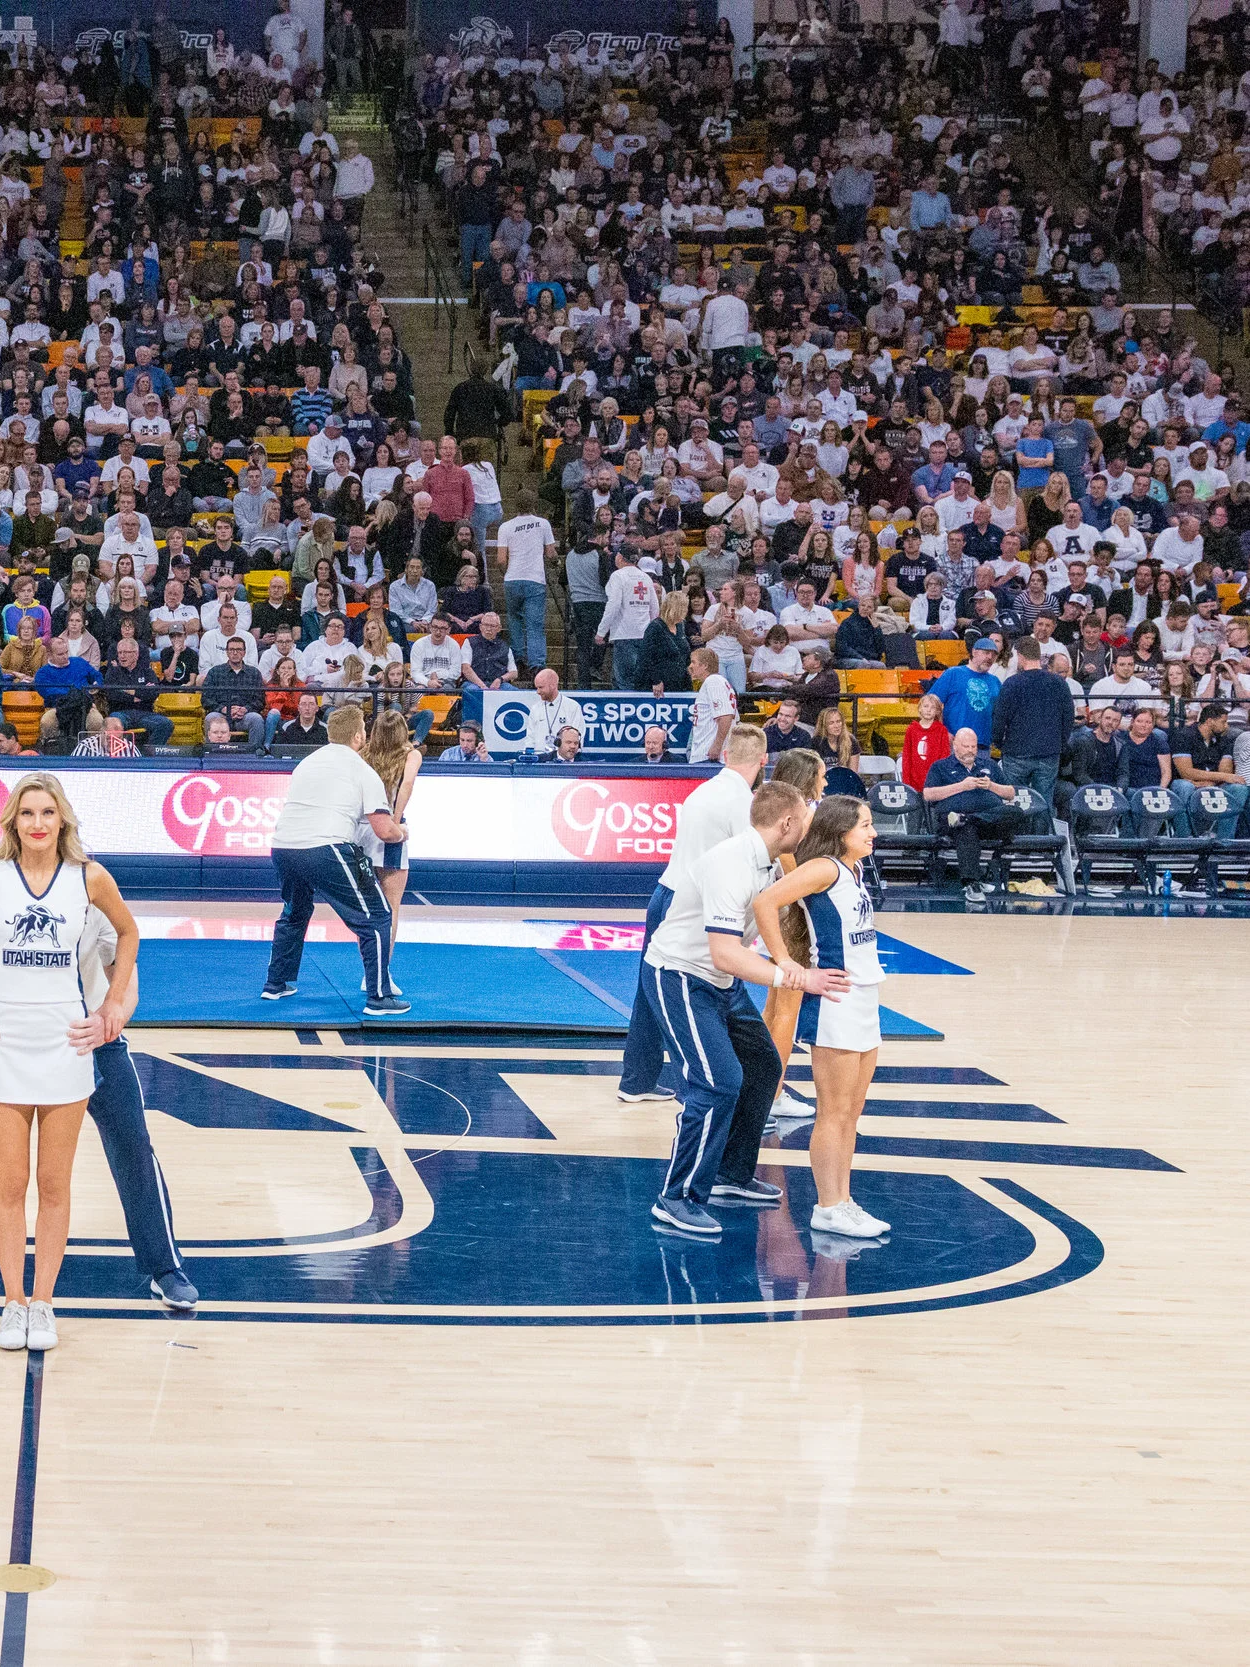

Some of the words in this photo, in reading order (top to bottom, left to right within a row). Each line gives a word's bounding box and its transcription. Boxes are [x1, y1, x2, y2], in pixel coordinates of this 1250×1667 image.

[173, 776, 288, 850] Goss
[2, 949, 35, 967] UTAH
[35, 950, 72, 968] STATE
